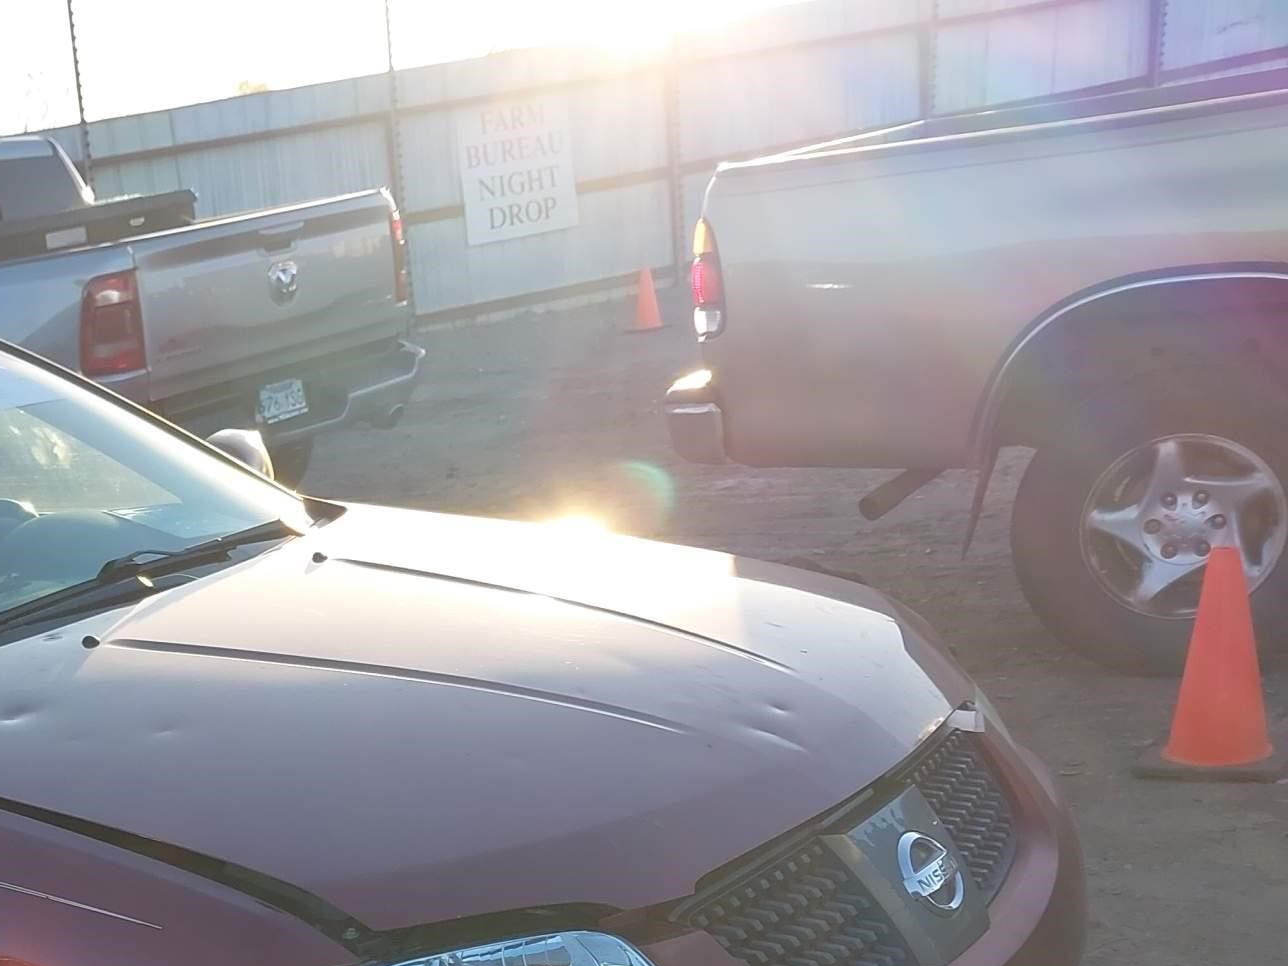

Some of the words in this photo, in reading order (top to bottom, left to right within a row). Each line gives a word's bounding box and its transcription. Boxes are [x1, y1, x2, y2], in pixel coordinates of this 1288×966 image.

[480, 103, 545, 135] FARM
[465, 130, 561, 169] BUREAU
[478, 164, 560, 202] NIGHT
[488, 196, 558, 230] DROP
